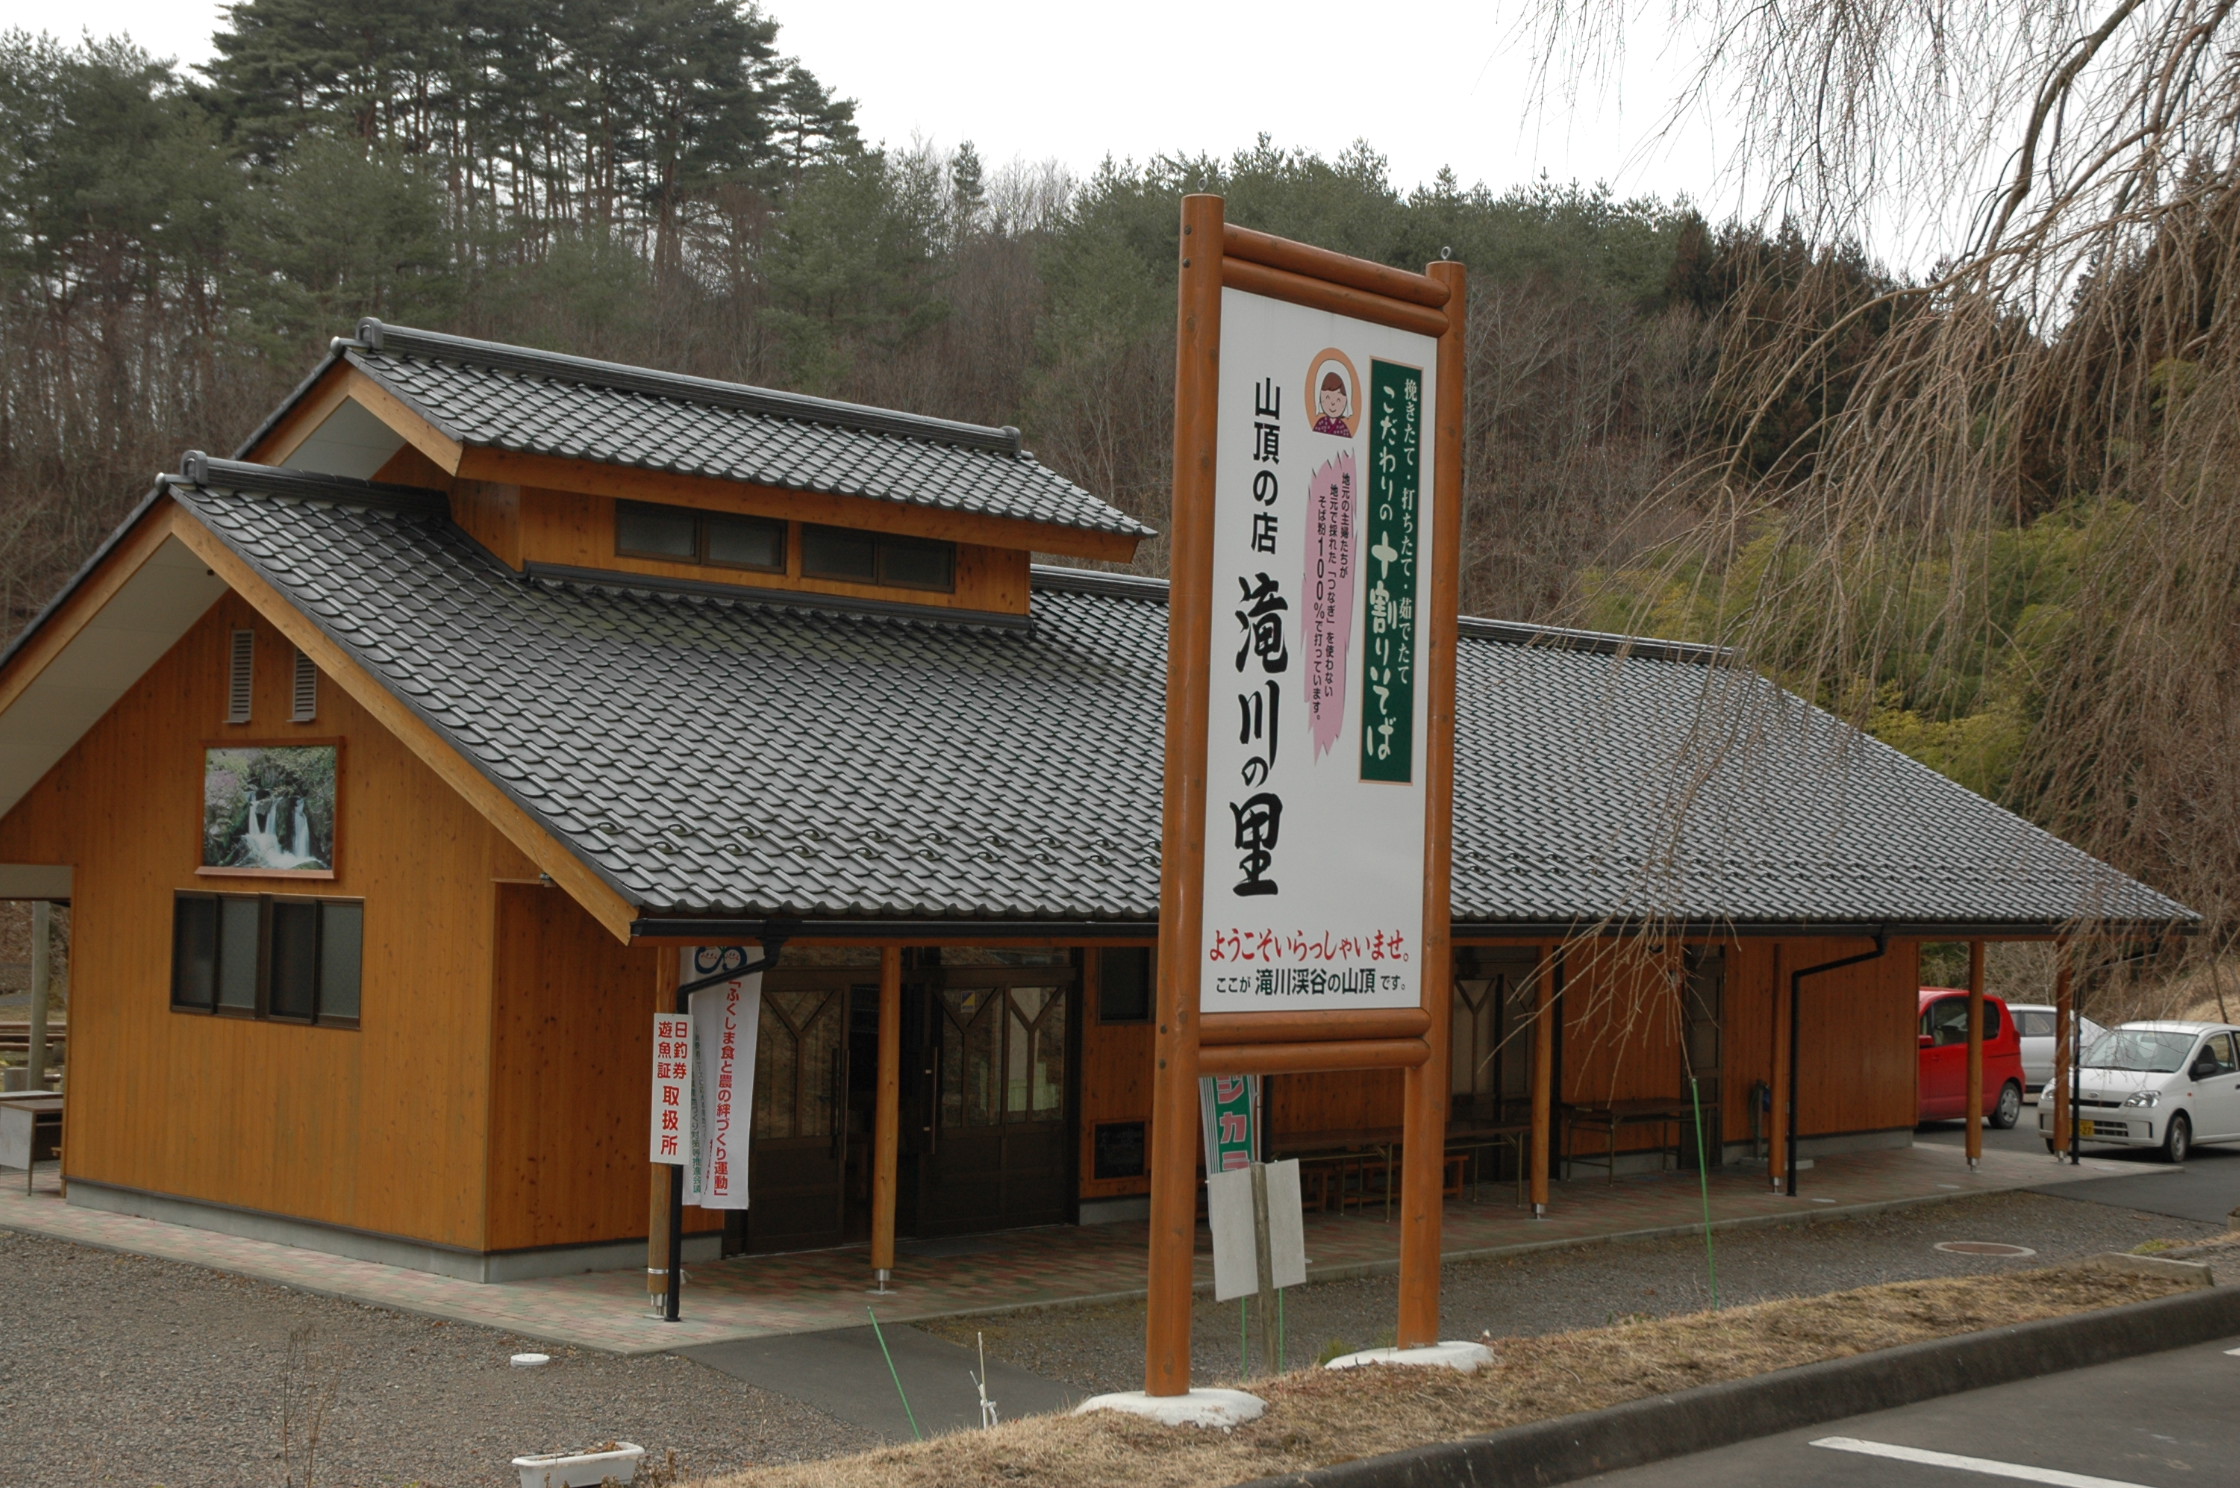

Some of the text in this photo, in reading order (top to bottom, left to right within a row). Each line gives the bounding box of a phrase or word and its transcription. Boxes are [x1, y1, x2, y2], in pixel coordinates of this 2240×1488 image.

[1251, 377, 1281, 555] 山頂の店
[1339, 472, 1351, 579] 地元の主婦たちが
[1230, 572, 1289, 897] 滝川の里
[1209, 928, 1409, 962] ようこそいらっしゃいませ。
[660, 1085, 681, 1156] 取扱所
